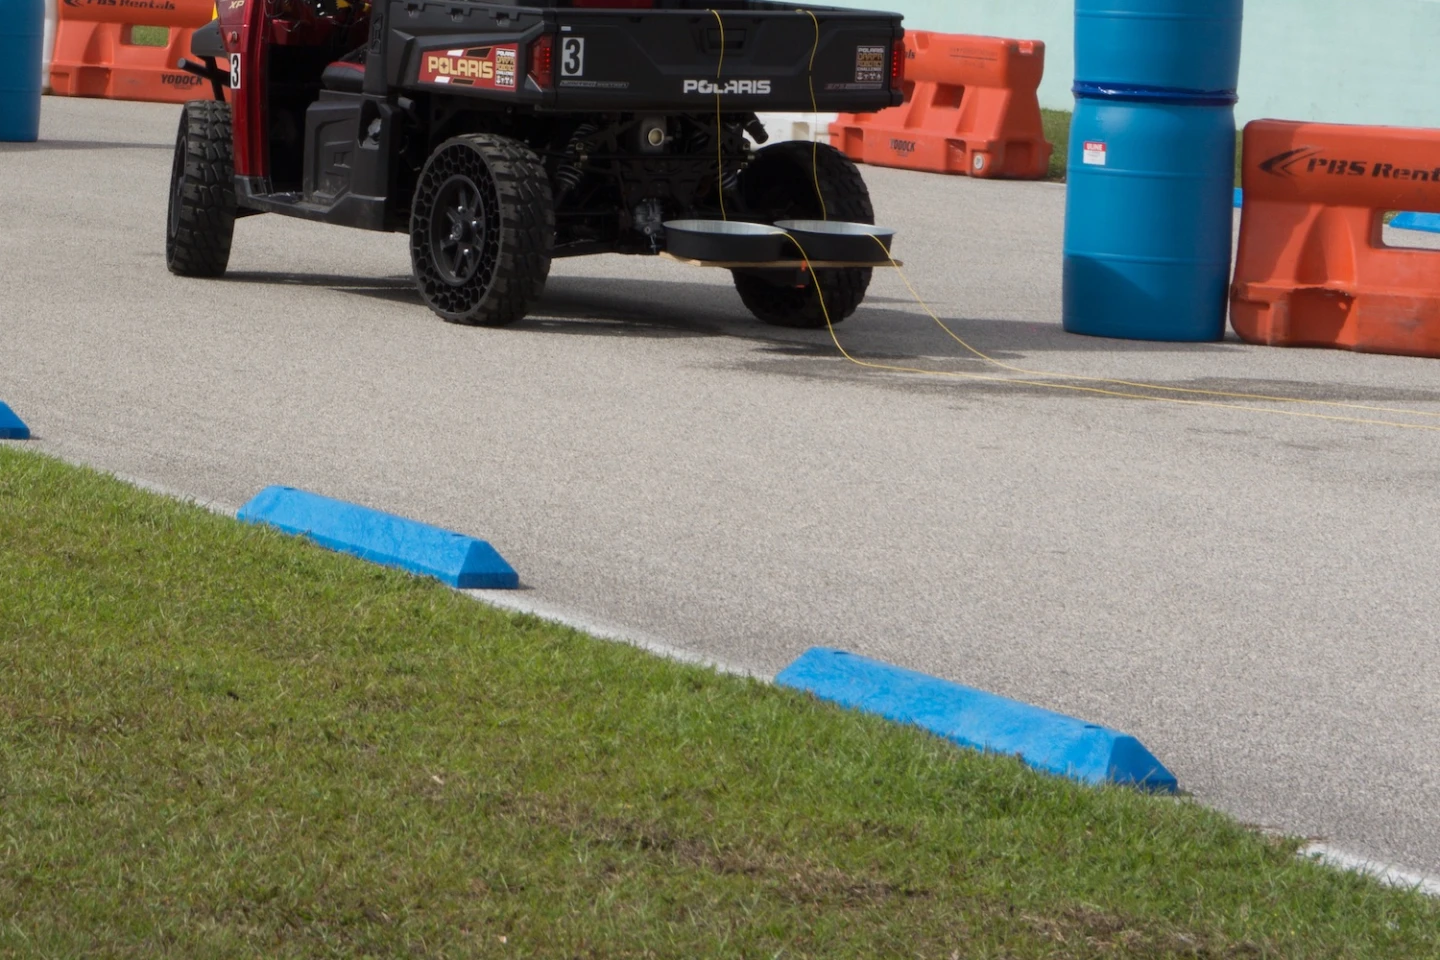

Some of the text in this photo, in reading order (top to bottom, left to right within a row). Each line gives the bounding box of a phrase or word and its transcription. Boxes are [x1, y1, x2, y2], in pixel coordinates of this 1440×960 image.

[228, 0, 245, 10] XP
[563, 38, 581, 75] 3
[231, 54, 240, 88] 3
[428, 56, 494, 79] POLARIS
[161, 73, 203, 86] YODOCK
[683, 79, 771, 94] POLARIS
[1306, 157, 1367, 177] PBS
